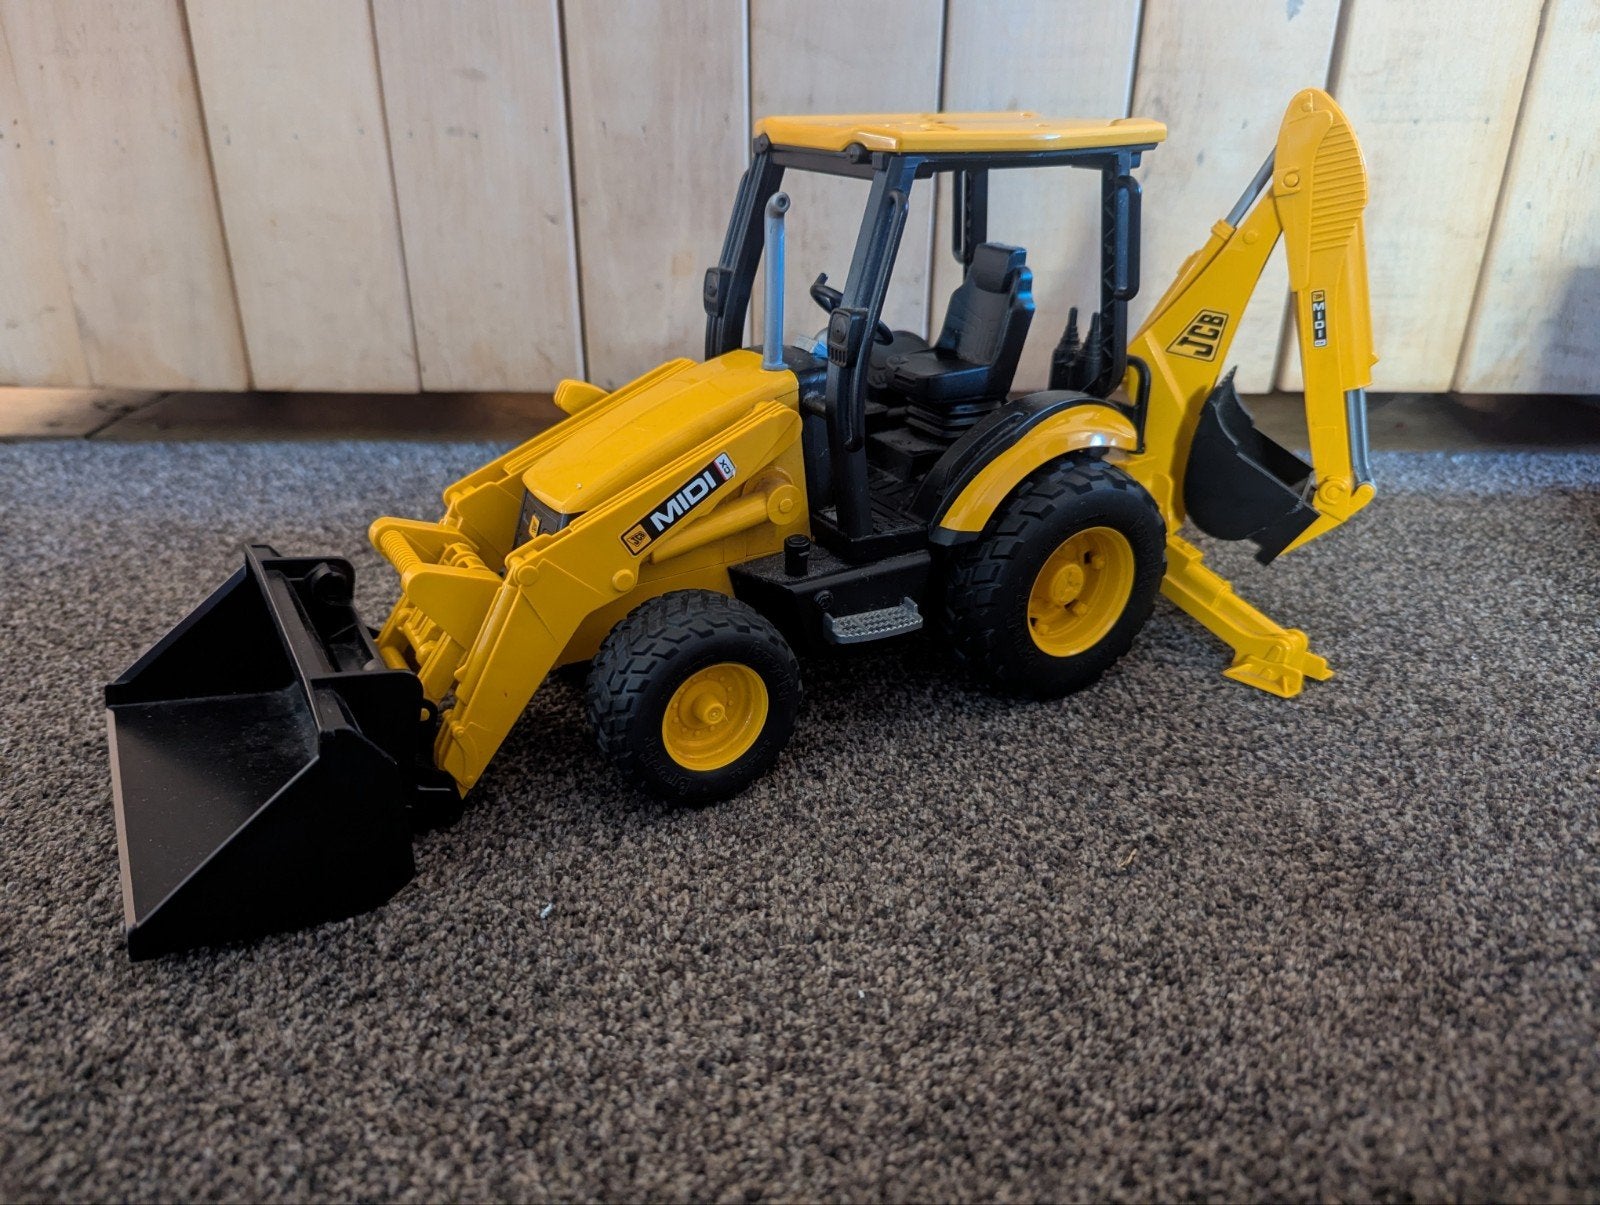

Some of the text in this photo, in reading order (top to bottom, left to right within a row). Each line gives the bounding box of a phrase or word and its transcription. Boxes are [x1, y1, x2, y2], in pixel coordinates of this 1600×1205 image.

[1176, 314, 1224, 357] JCB
[1313, 302, 1325, 338] MIDI
[630, 471, 717, 546] JCB MIDI
